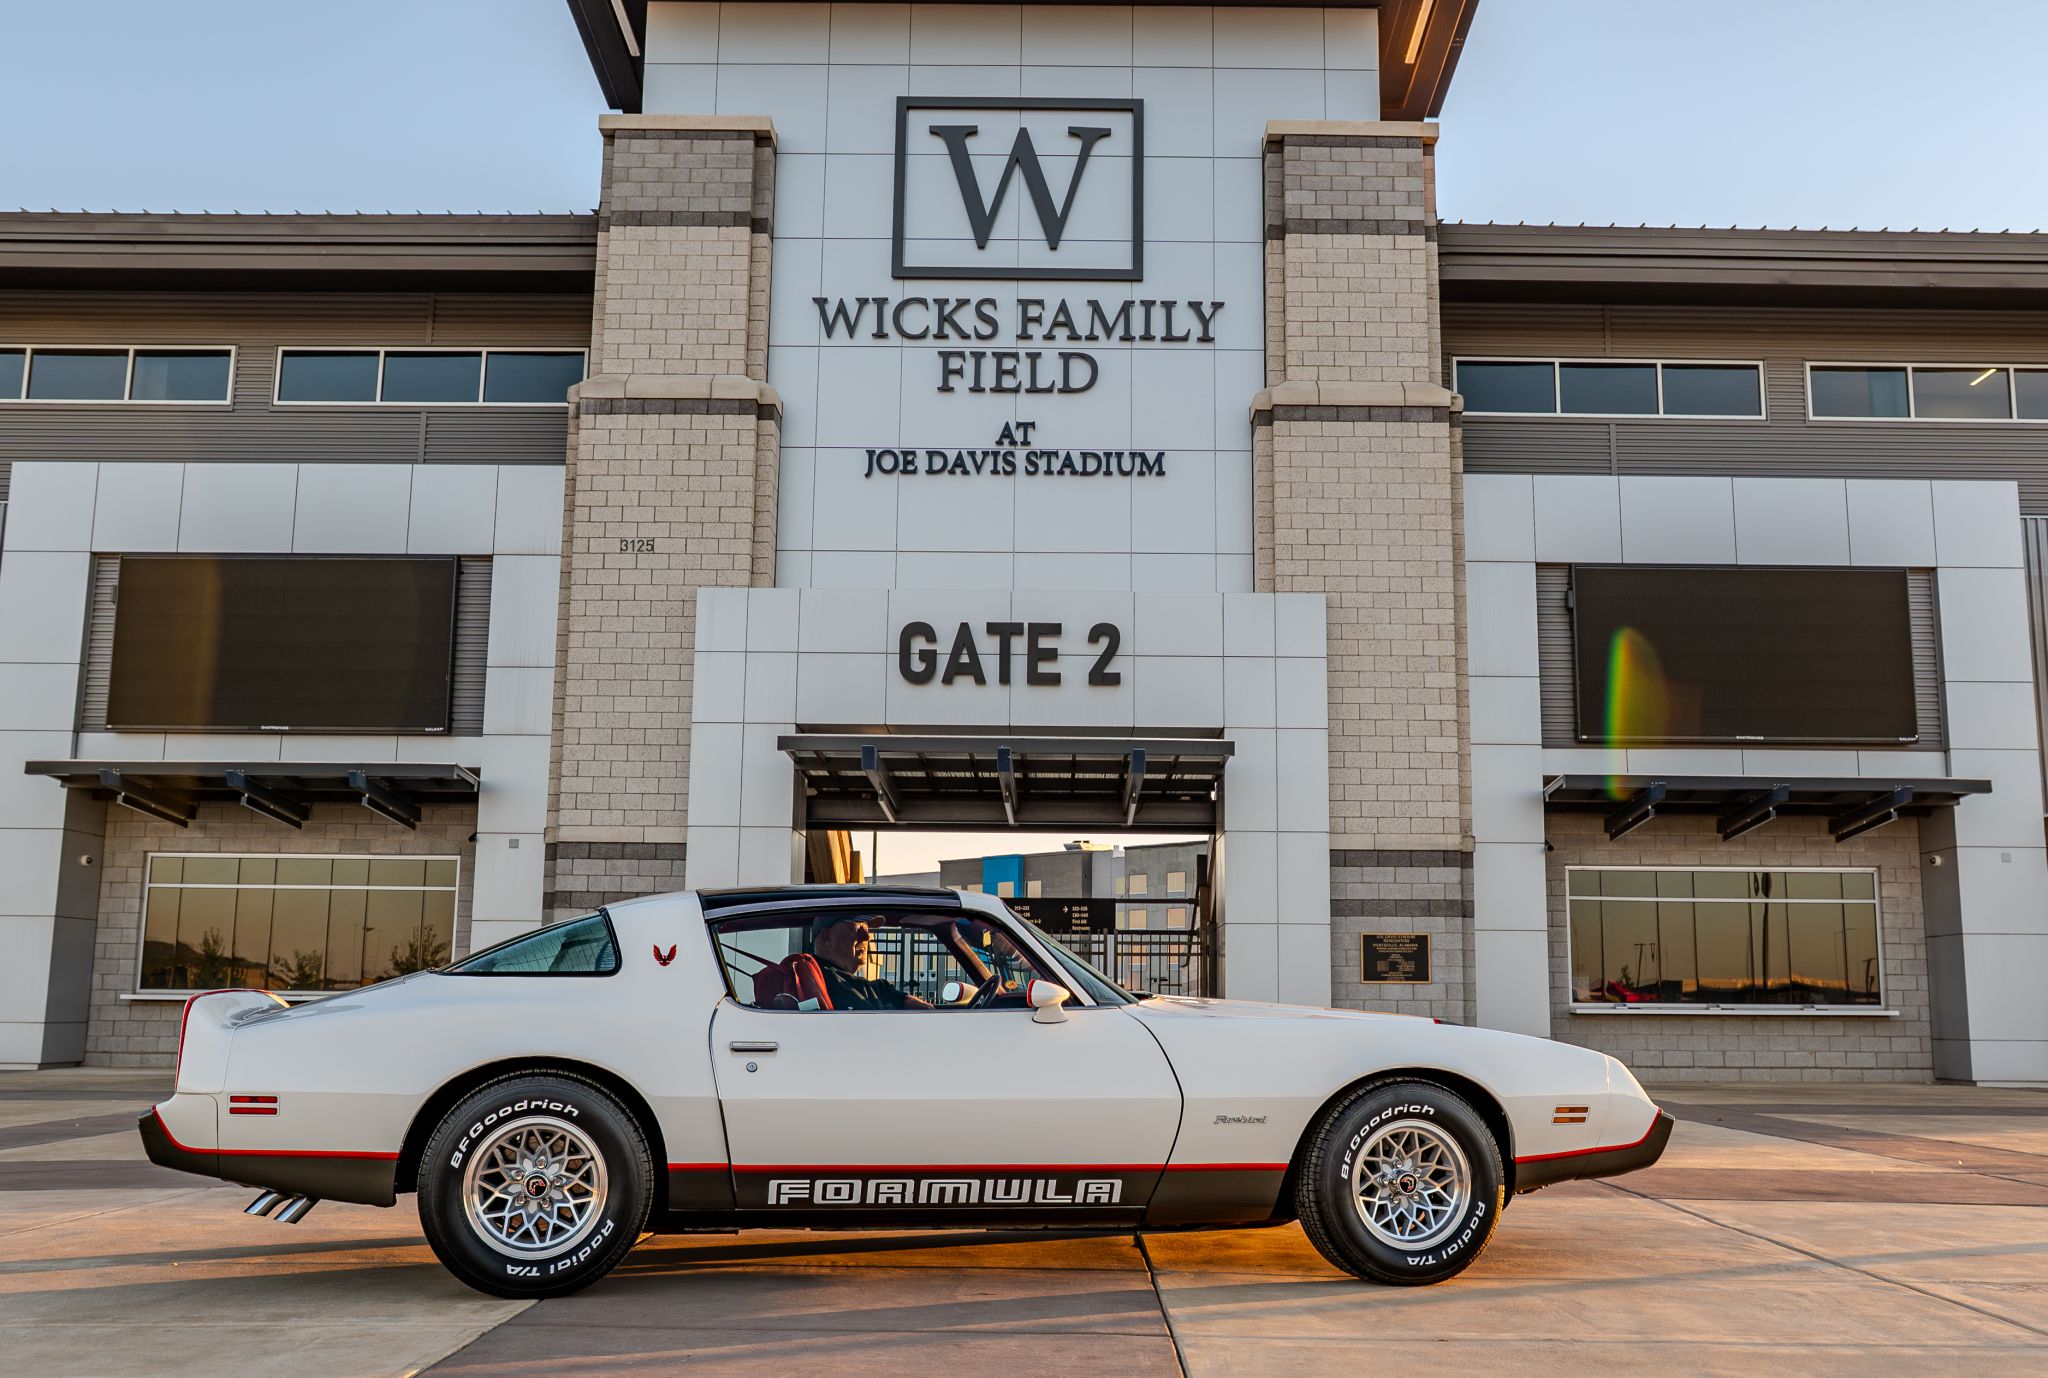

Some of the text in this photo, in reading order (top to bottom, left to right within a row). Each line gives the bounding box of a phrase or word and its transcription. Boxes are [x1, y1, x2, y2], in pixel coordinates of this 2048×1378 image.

[928, 124, 1112, 251] W
[812, 297, 1225, 342] WICKS FAMILY
[936, 350, 1099, 393] FIELD
[995, 421, 1036, 446] AT
[864, 449, 1166, 478] JOE DAVIS STADIUM
[620, 539, 655, 552] 3125
[899, 621, 1122, 686] GATE 2
[450, 1099, 579, 1169] BFGoodrich
[1340, 1103, 1435, 1180] BFGoodrich
[767, 1179, 1123, 1205] FORMULA
[506, 1218, 615, 1277] Radial T/A
[1406, 1200, 1487, 1266] Radial T/A
